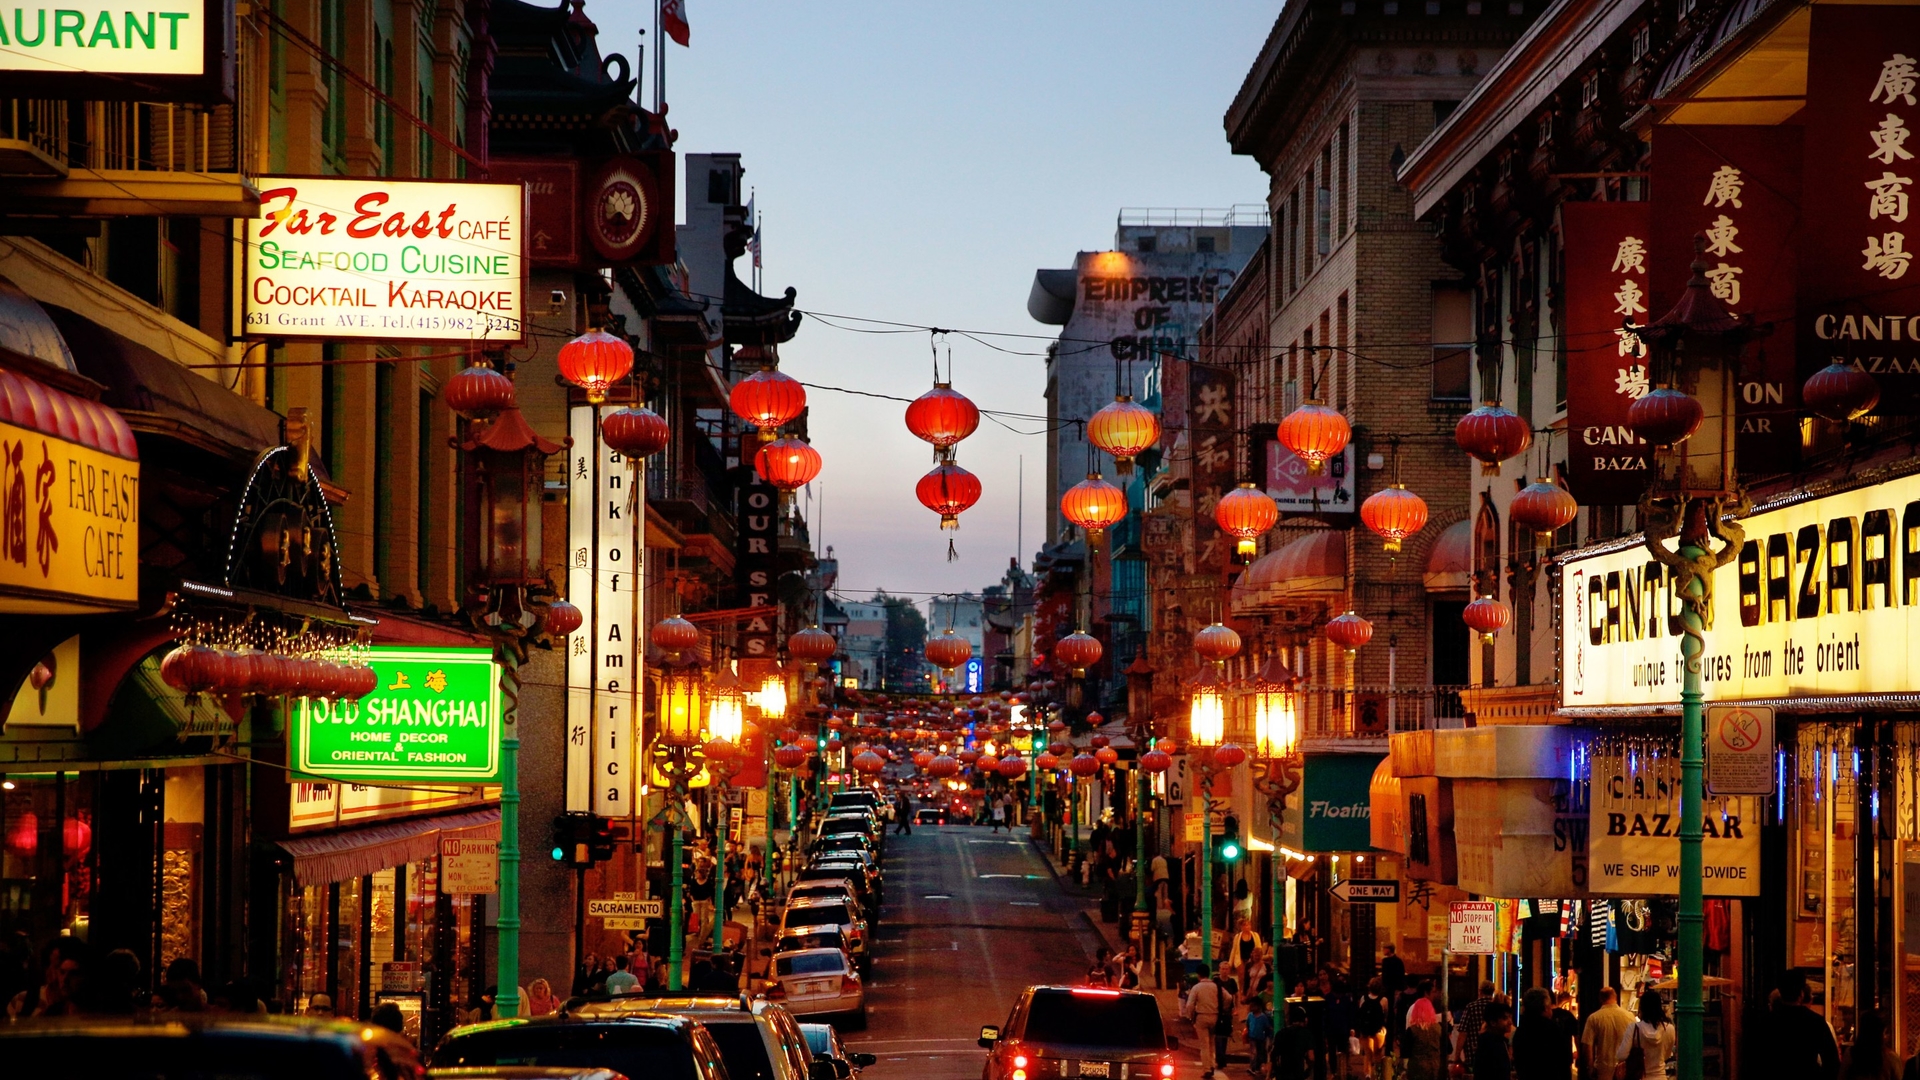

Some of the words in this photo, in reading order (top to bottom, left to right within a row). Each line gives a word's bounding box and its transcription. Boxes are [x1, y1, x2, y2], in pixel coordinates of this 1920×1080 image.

[1862, 53, 1920, 280] 廣東商場
[259, 187, 337, 238] Far
[346, 192, 457, 239] East
[458, 216, 512, 240] CAFÉ
[259, 241, 388, 272] SEAFOOD
[401, 245, 510, 275] CUISINE
[1703, 165, 1745, 320] 廣東商
[253, 277, 376, 307] COCKTAIL
[388, 280, 512, 311] KARAOKE
[1081, 276, 1218, 303] EMPRESS
[247, 312, 271, 325] 631
[278, 313, 326, 327] Grant
[335, 314, 375, 329] AVE.
[1135, 306, 1171, 330] OF
[1611, 236, 1650, 400] 廣東商場
[1738, 382, 1784, 405] ON
[69, 459, 98, 517] FAR
[102, 469, 138, 523] EAST
[609, 450, 622, 519] ank
[84, 523, 124, 580] CAFÉ
[609, 548, 622, 592] of
[571, 456, 588, 746] 美國銀行
[747, 571, 770, 654] SEAS
[1588, 560, 1716, 646] CANTO
[1633, 657, 1667, 693] unique
[1675, 652, 1732, 687] trures
[1744, 644, 1772, 679] from
[1784, 638, 1804, 676] the
[1816, 632, 1860, 672] orient
[314, 697, 359, 724] OLD
[366, 697, 487, 728] SHANGHAI
[606, 624, 624, 801] America
[351, 731, 391, 743] HOME
[400, 733, 448, 743] DECOR
[394, 742, 404, 752] &
[331, 750, 400, 762] ORIENTAL
[407, 752, 467, 763] FASHION
[445, 840, 459, 855] NO
[462, 844, 495, 855] PARKING
[1604, 864, 1624, 877] WE
[1630, 865, 1661, 878] SHIP
[1667, 865, 1747, 880] WDWIDE
[1349, 886, 1368, 896] ONE
[1372, 886, 1392, 896] WAY
[590, 902, 659, 914] SACRAMENTO
[1451, 911, 1463, 923] NO
[1463, 913, 1493, 924] STOPPING
[1453, 903, 1493, 911] TOW-AWAY
[1462, 935, 1482, 945] TIME
[1463, 925, 1481, 935] ANY
